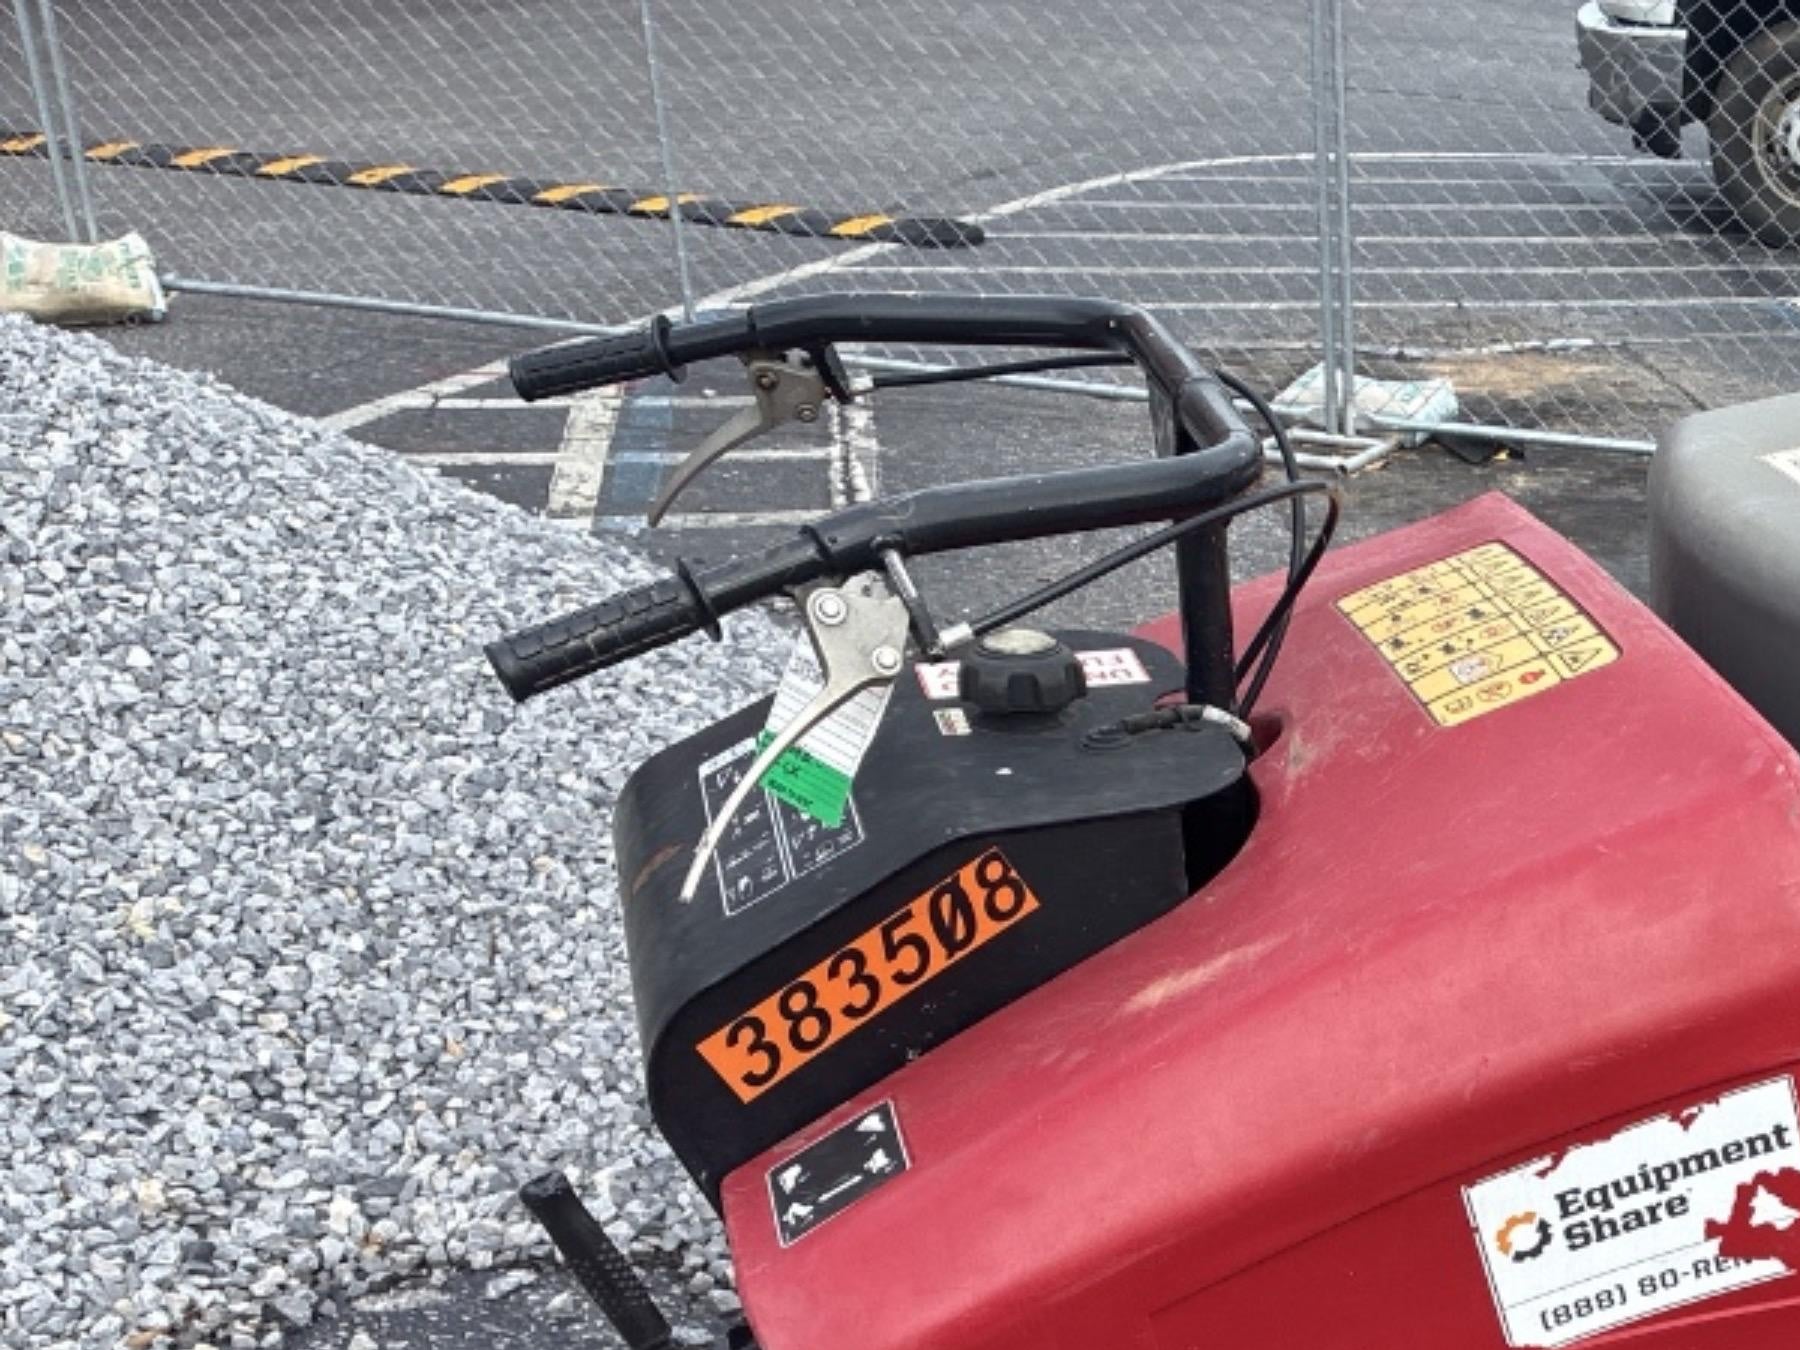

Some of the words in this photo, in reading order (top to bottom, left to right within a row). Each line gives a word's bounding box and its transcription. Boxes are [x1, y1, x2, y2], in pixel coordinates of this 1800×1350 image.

[725, 853, 1028, 1087] 383508
[1554, 1122, 1793, 1219] Equipment
[1563, 1192, 1692, 1252] Share
[1540, 1284, 1629, 1332] (888)
